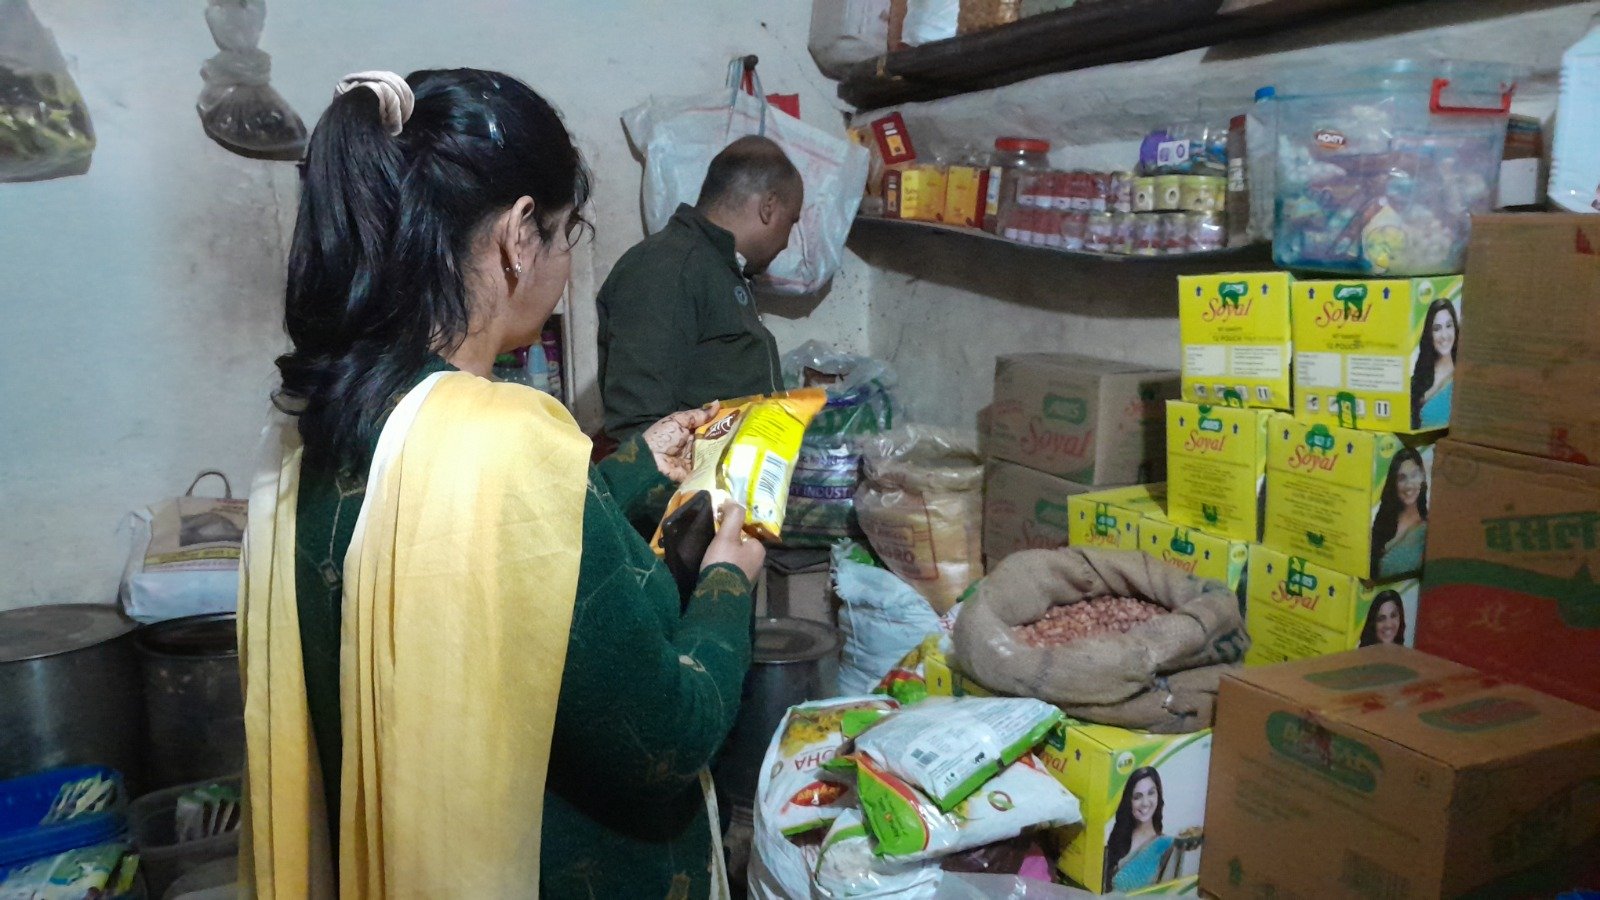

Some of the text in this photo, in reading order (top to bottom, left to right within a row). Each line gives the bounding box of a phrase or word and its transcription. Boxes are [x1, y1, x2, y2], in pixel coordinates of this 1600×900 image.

[1202, 297, 1253, 323] Soyal
[1315, 301, 1372, 329] Soyal
[1019, 416, 1095, 461] Soyal
[1184, 430, 1228, 455] Soyal
[1287, 444, 1339, 473] Soyal
